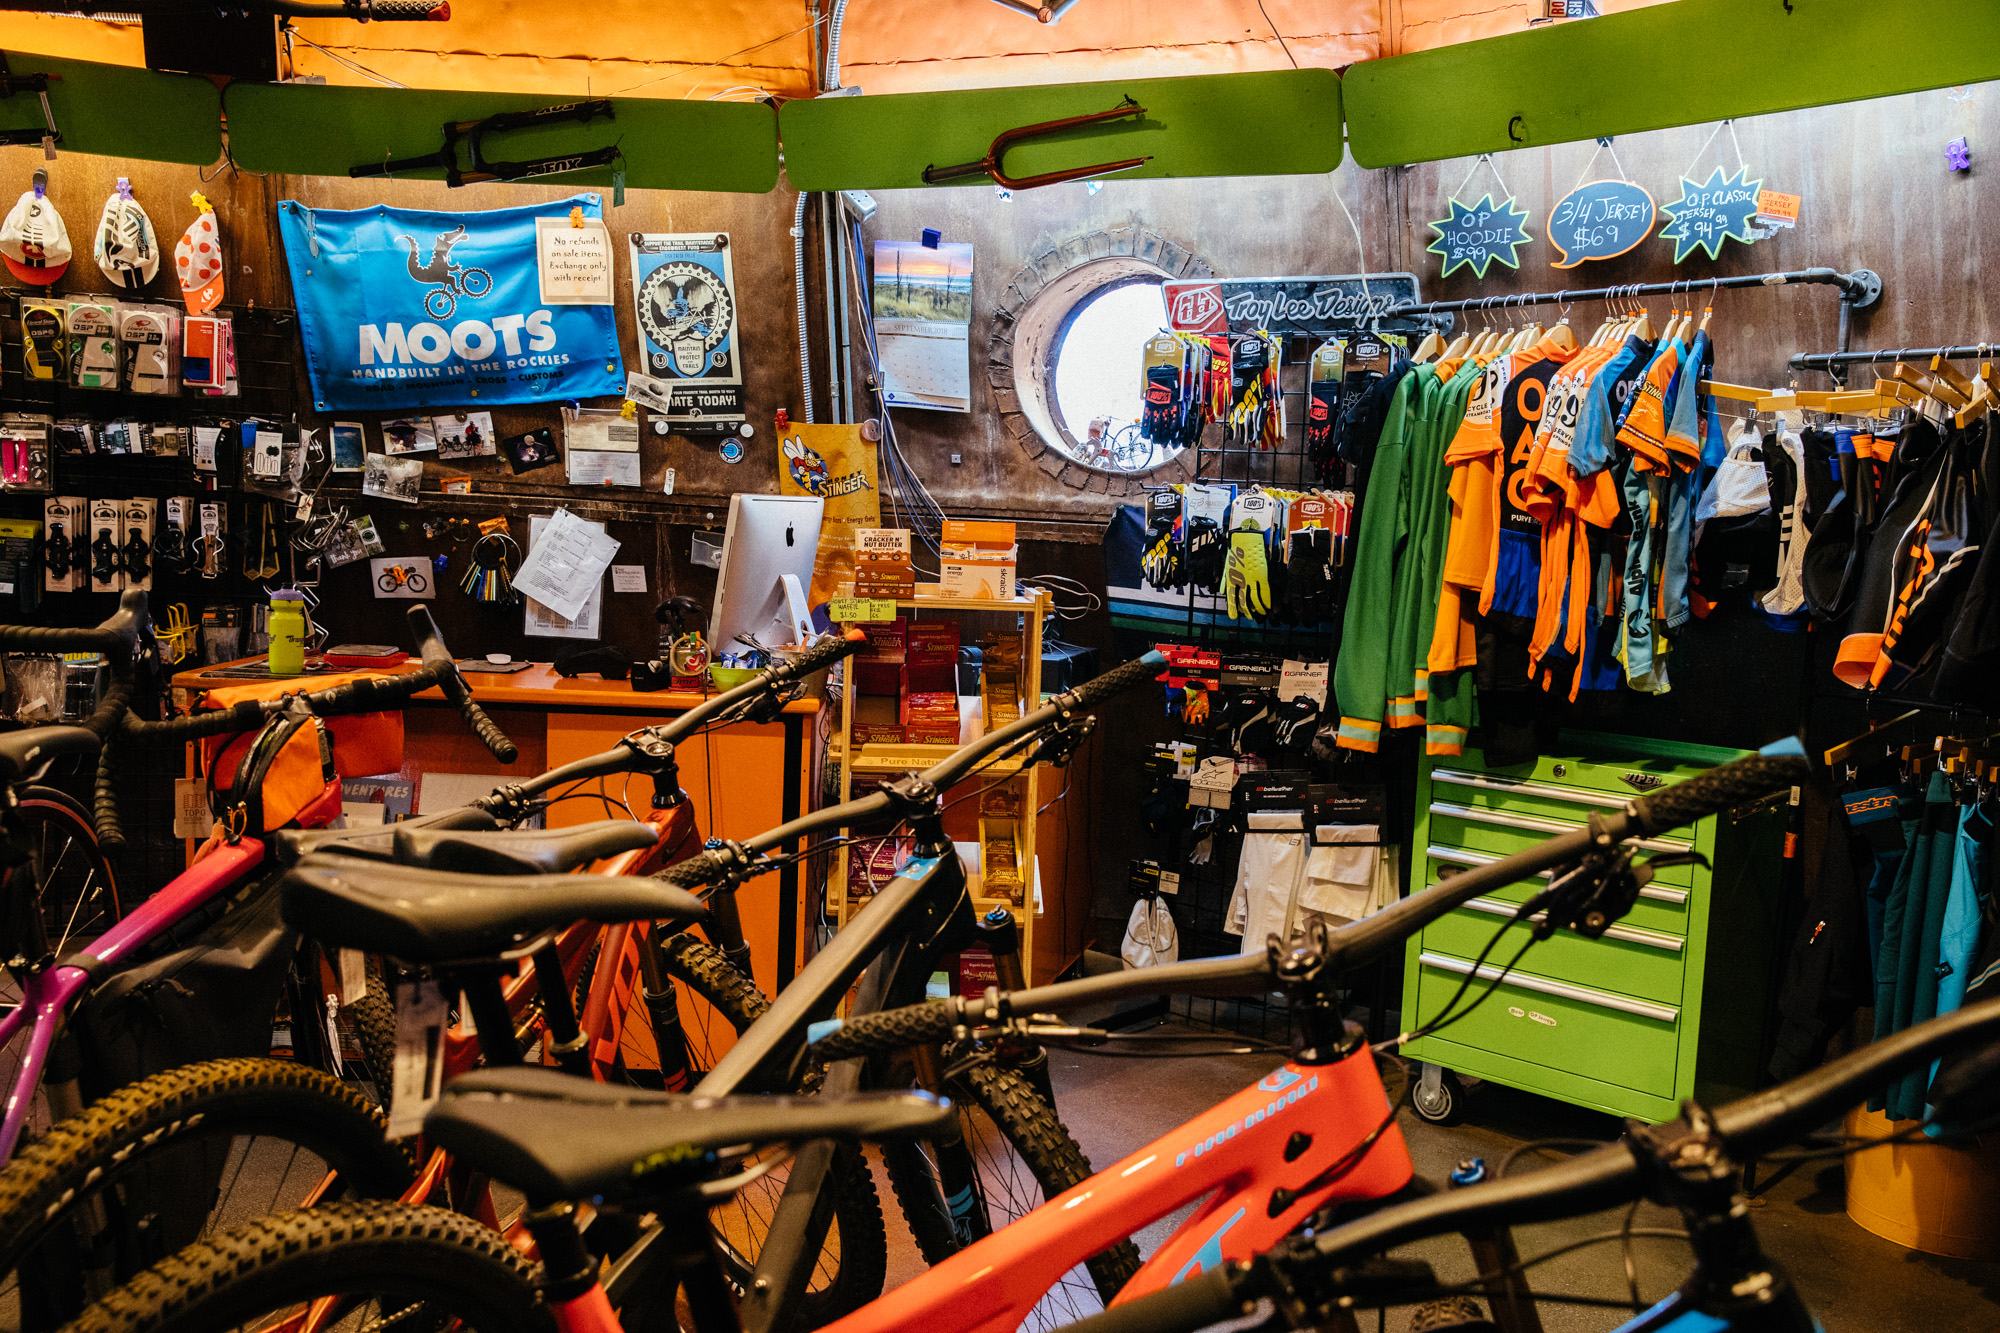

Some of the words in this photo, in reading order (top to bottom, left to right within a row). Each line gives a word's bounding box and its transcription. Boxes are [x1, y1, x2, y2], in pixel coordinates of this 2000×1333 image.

[1712, 190, 1752, 206] CLASSIC
[1764, 200, 1792, 209] JERSEY
[1557, 196, 1593, 226] 3/4
[1595, 196, 1650, 223] JERSEY
[1675, 207, 1716, 225] JERSEY
[1461, 211, 1492, 228] OP
[554, 237, 566, 245] No
[569, 236, 600, 246] refunds
[1447, 227, 1513, 247] HOODIE
[1571, 225, 1619, 252] $69
[563, 249, 579, 258] sale
[1451, 246, 1487, 261] $99
[549, 261, 588, 272] Exchange
[589, 261, 607, 272] only
[553, 273, 572, 282] with
[573, 275, 604, 284] receipt.
[1224, 291, 1272, 332] Troy
[1271, 291, 1316, 322] Lee
[1313, 287, 1405, 330] Designs
[894, 325, 933, 335] SEPTEMBER
[933, 327, 949, 335] 2018
[359, 309, 557, 365] MOOTS
[352, 367, 440, 378] HANDBUILT
[447, 366, 466, 376] IN
[470, 361, 500, 373] THE
[506, 354, 570, 370] ROCKIES
[365, 384, 396, 393] ROAD
[406, 378, 465, 390] MOUNTAIN
[475, 376, 508, 385] CROSS
[518, 370, 564, 382] CUSTOMS
[697, 395, 737, 406] TODAY!
[818, 474, 871, 499] STINGER
[1246, 500, 1262, 508] 100%
[1304, 503, 1322, 512] 100%
[846, 515, 864, 525] Energy
[864, 515, 876, 523] Gels
[329, 550, 351, 564] thank
[350, 548, 363, 560] you
[925, 642, 955, 652] STINGER
[1177, 657, 1219, 666] GARNEAU
[1229, 664, 1272, 673] GARNEAU
[869, 734, 901, 743] STINGER
[923, 735, 955, 744] STINGER
[880, 758, 910, 766] Pure
[911, 758, 943, 766] Natu
[1625, 773, 1662, 785] VIPER
[185, 809, 206, 817] TOPO
